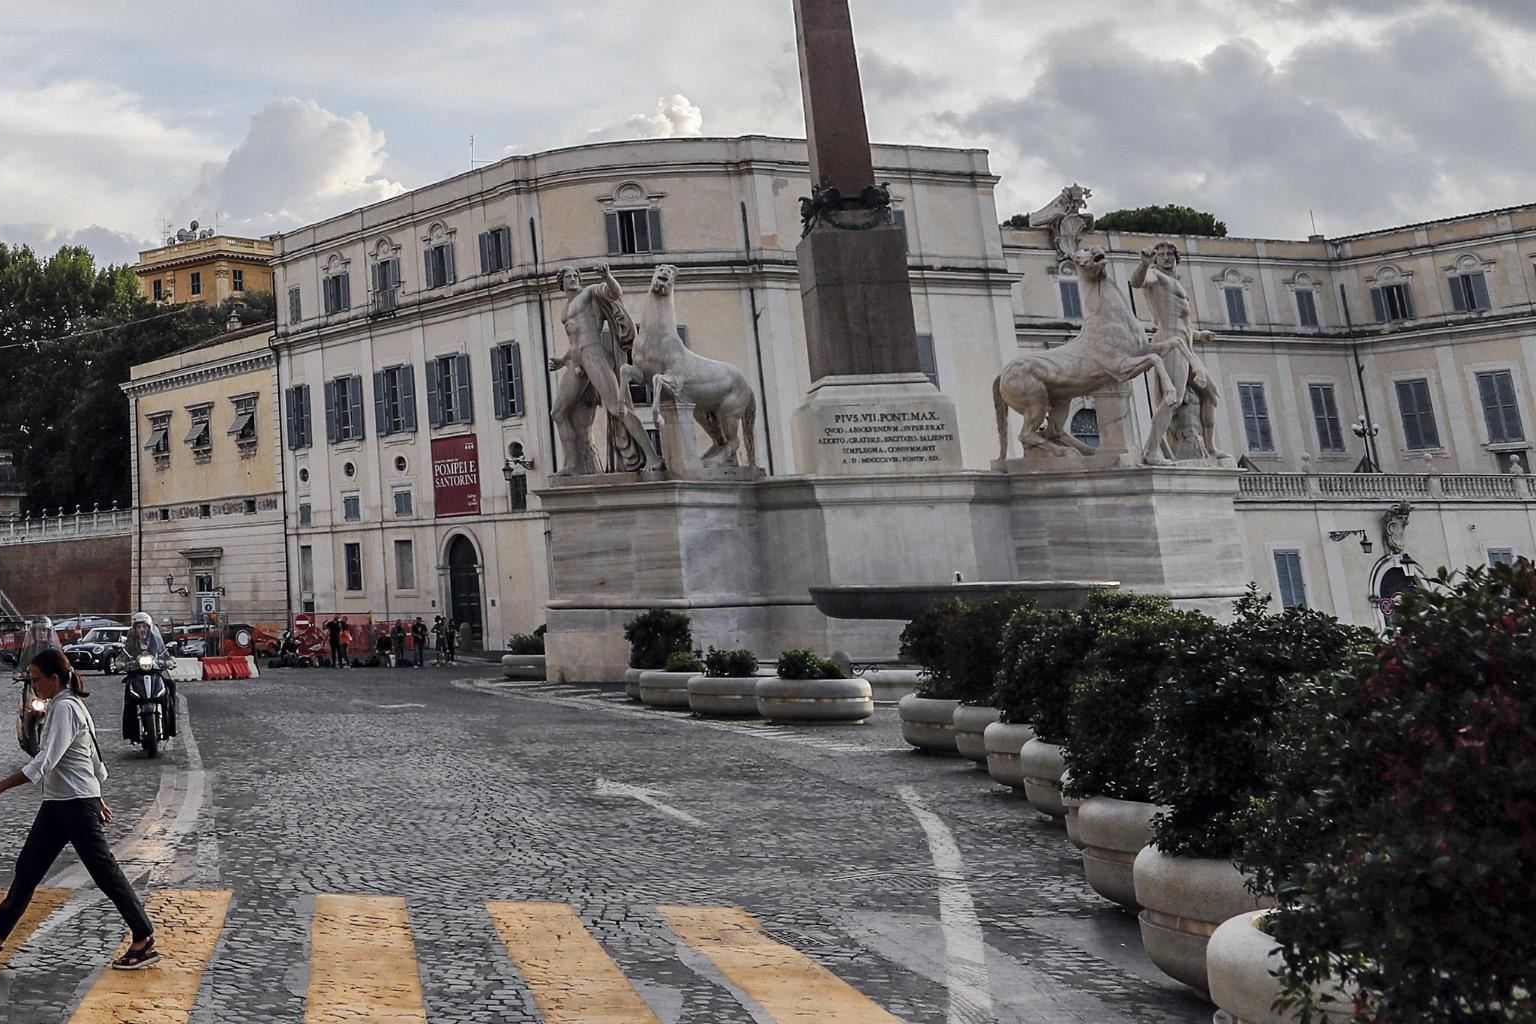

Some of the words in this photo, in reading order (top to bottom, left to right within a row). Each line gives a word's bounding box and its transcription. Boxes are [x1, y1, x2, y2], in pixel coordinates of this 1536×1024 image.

[434, 462, 467, 476] POMPEI
[469, 460, 477, 472] E
[435, 474, 477, 488] SANTORINI
